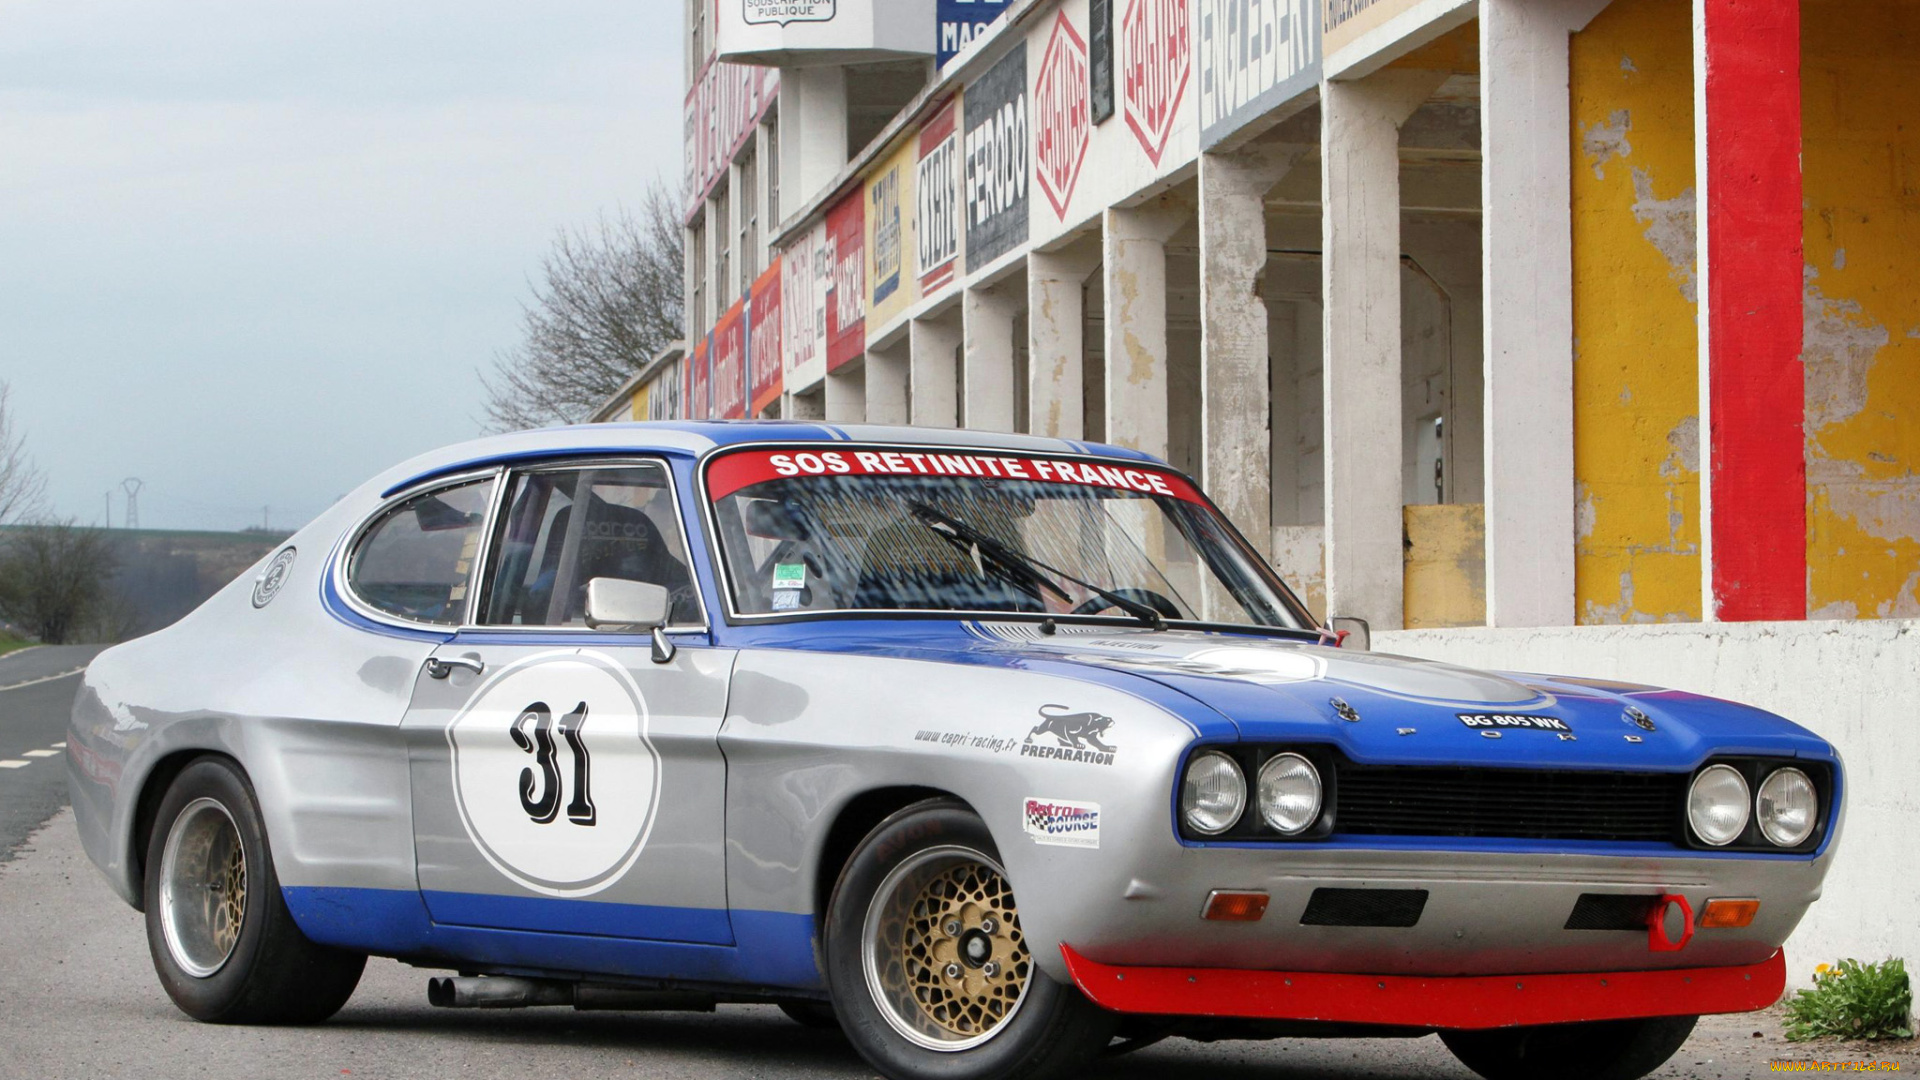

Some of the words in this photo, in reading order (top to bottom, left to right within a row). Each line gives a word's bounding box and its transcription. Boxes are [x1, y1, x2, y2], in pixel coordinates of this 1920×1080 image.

[758, 6, 815, 16] PUBLIQUE
[1127, 0, 1187, 136] JAGUAR
[1038, 35, 1086, 194] JAGUAR
[966, 94, 1026, 231] FERODO
[769, 452, 850, 475] SOS
[854, 452, 1029, 478] RETINITE
[1031, 460, 1174, 496] FRANCE
[580, 520, 648, 538] parco
[1460, 715, 1493, 726] BG
[1493, 716, 1531, 726] 805
[1528, 717, 1568, 730] WK
[510, 701, 597, 826] 31
[1020, 744, 1115, 766] PREPARATION
[1047, 812, 1098, 834] COURSE
